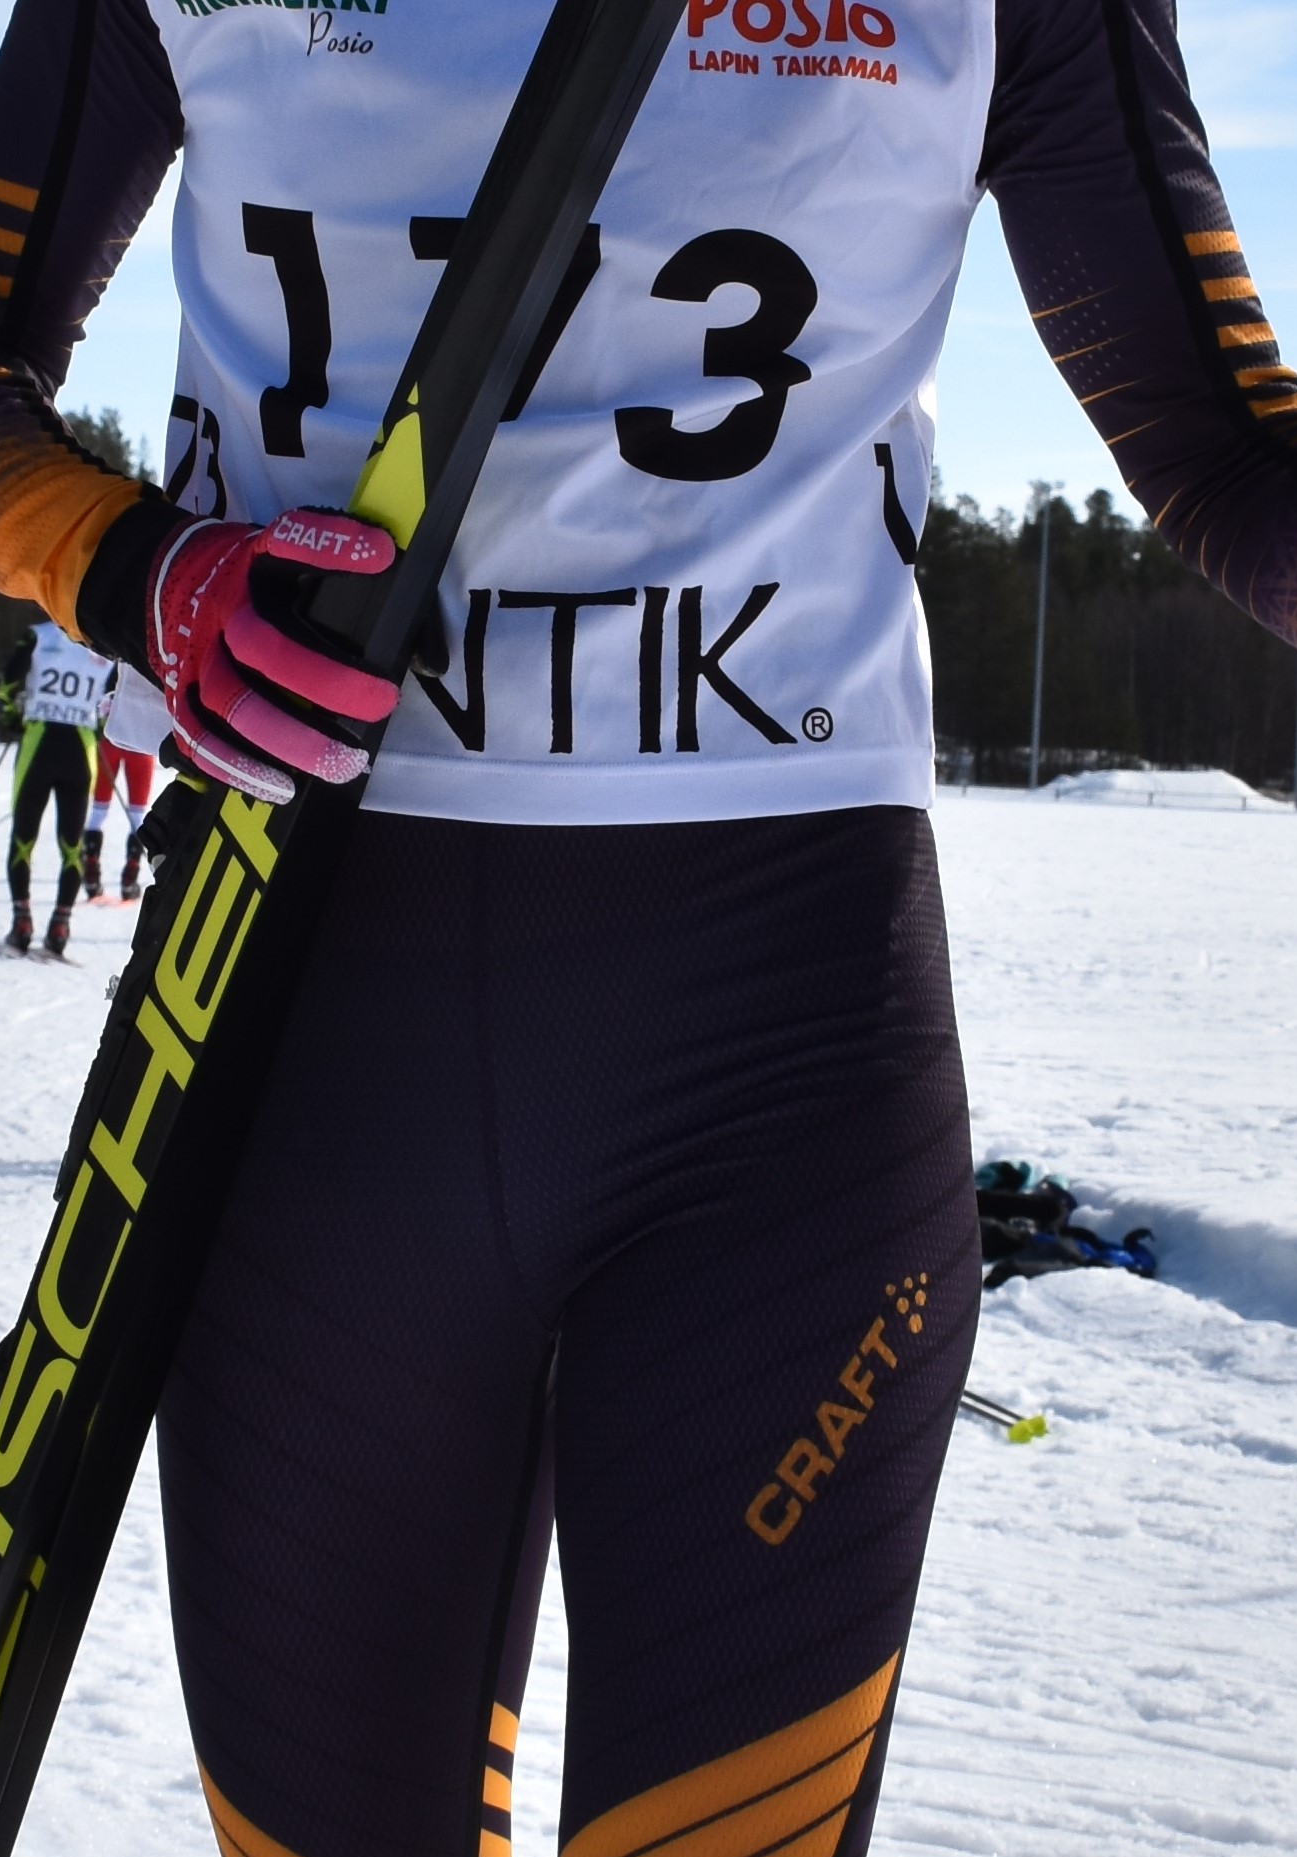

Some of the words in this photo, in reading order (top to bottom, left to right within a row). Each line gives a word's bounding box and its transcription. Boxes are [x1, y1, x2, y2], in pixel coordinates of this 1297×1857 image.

[306, 11, 374, 57] Posio
[689, 50, 760, 75] LAPIN
[773, 55, 898, 85] TAIKAMAA
[272, 516, 351, 555] CRAFT
[39, 668, 95, 702] 201
[744, 1315, 898, 1546] CRAFT
